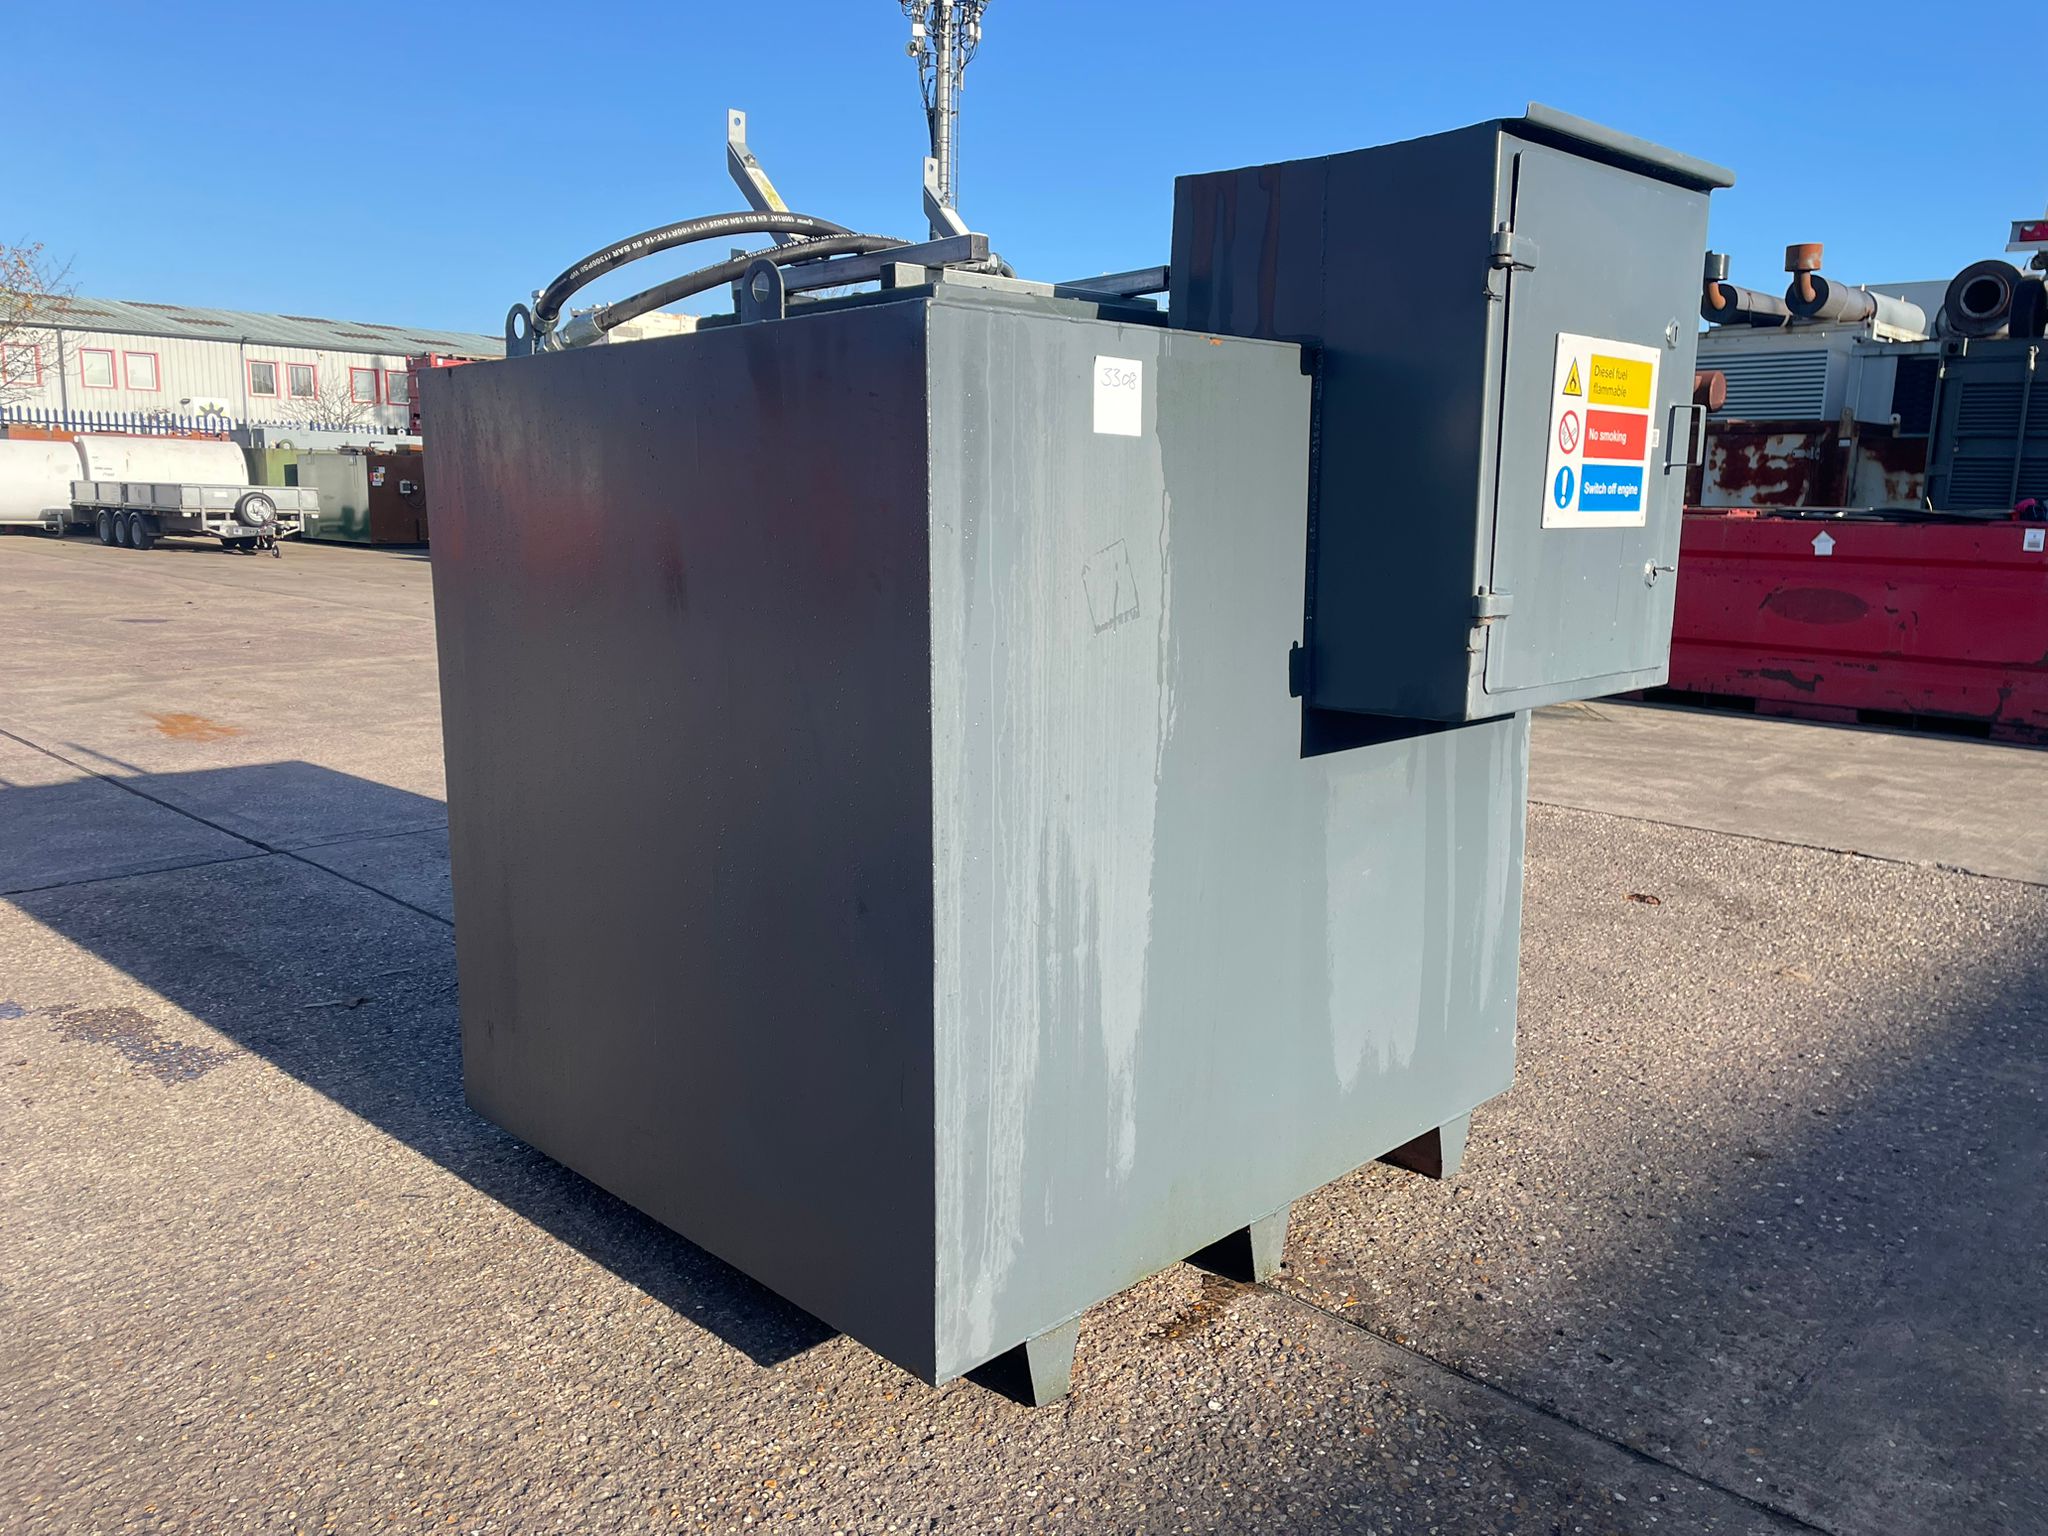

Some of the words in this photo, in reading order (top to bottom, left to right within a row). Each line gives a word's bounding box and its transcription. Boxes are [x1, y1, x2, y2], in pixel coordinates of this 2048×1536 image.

[709, 218, 729, 228] DN25
[644, 226, 692, 244] 100R1AT-16
[612, 245, 630, 257] BAR
[632, 240, 642, 249] 88
[570, 270, 580, 280] WP
[1101, 367, 1137, 390] 3308
[1594, 364, 1615, 379] Diesel
[1616, 368, 1628, 380] fuel
[1593, 382, 1627, 398] flammable
[1588, 428, 1598, 440] No
[1600, 430, 1627, 446] smoking
[1584, 481, 1606, 495] Switch
[1607, 482, 1617, 495] off
[1618, 483, 1638, 498] engine
